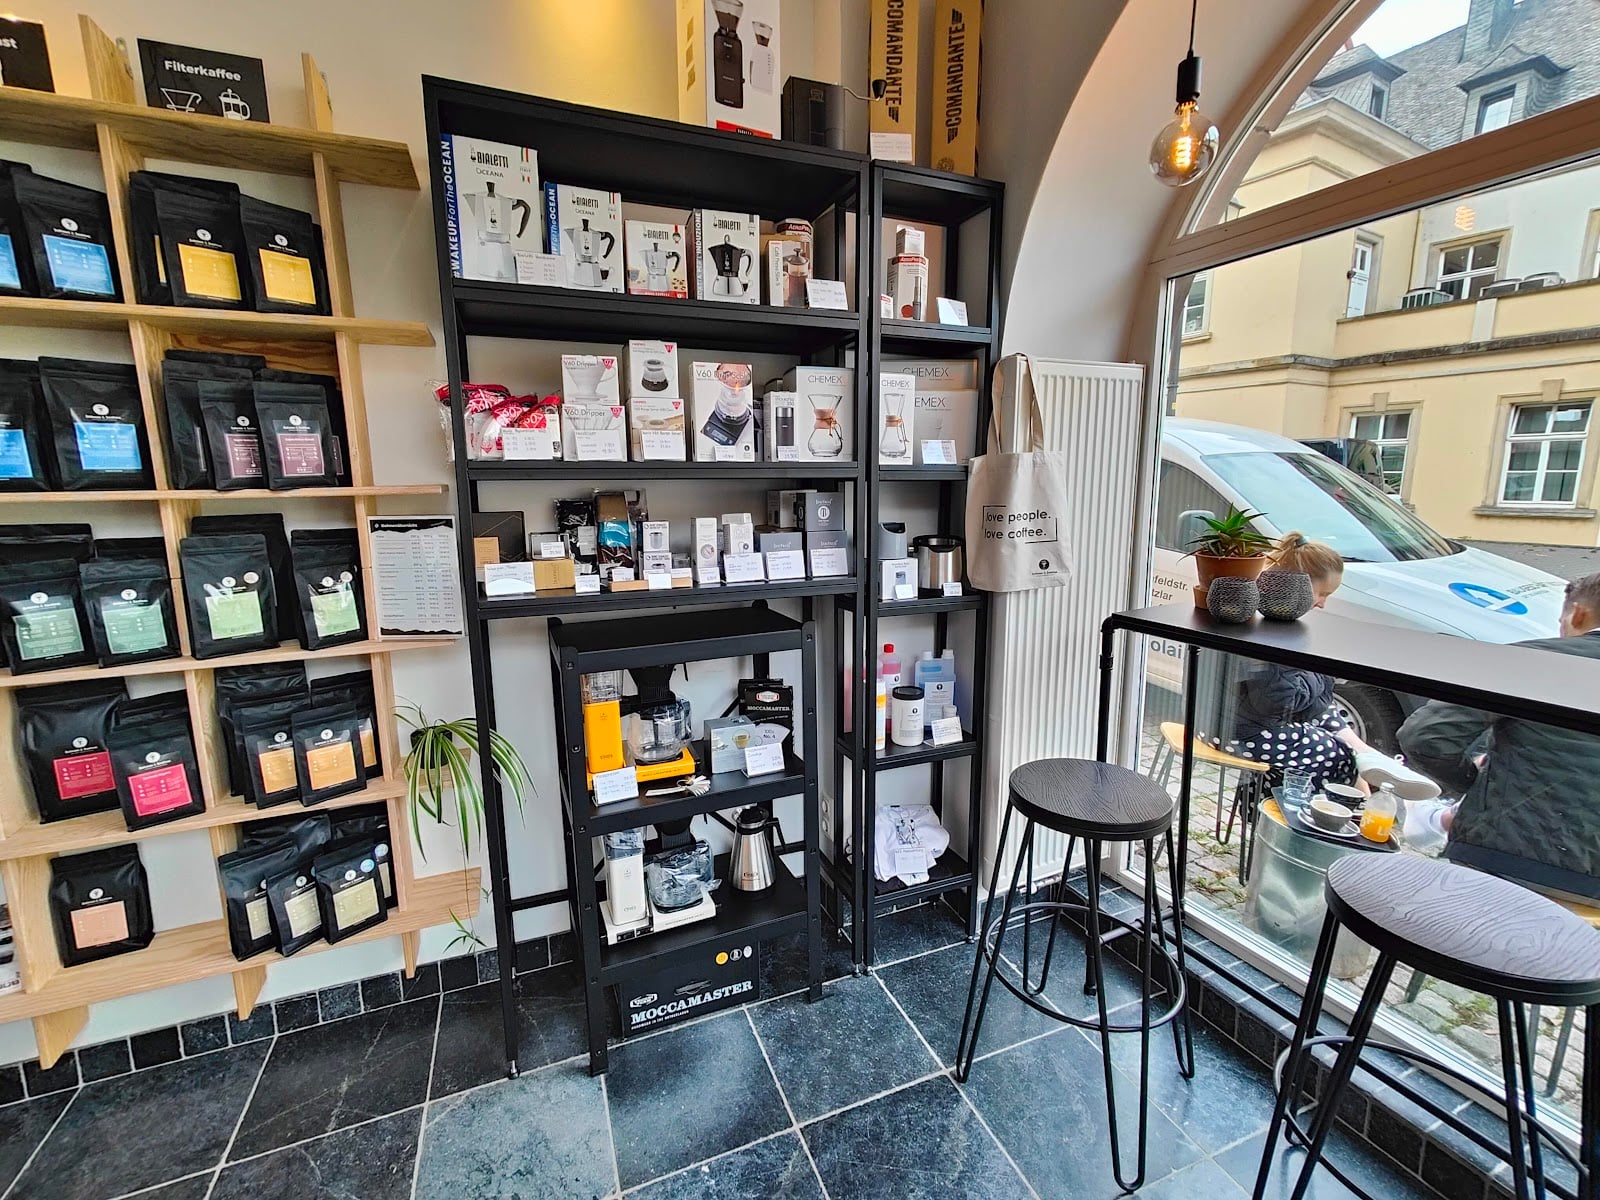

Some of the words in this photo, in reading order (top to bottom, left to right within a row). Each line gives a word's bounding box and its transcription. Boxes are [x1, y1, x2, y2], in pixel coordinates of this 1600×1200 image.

[885, 0, 904, 106] COMANDANTE
[164, 60, 242, 82] Filterkaffee
[945, 23, 965, 128] COMANDANTE
[476, 151, 509, 169] BIALETTI
[476, 168, 504, 178] OCEANA
[576, 196, 599, 209] BIALETTI
[717, 219, 741, 231] BIALETTI
[647, 229, 669, 241] BIALETTI
[696, 369, 712, 378] V60
[903, 367, 949, 378] CHEMEX
[807, 375, 842, 385] CHEMEX
[881, 379, 910, 388] CHEMEX
[914, 397, 946, 408] EMEX
[565, 408, 579, 417] V60
[580, 409, 605, 419] Dripper
[985, 512, 1004, 522] love
[1008, 509, 1051, 524] people.
[984, 529, 1004, 539] love
[1007, 527, 1047, 539] coffee.
[1153, 575, 1188, 591] feldstr.
[1150, 640, 1182, 659] olai
[630, 980, 753, 1025] MOCCAMASTER
